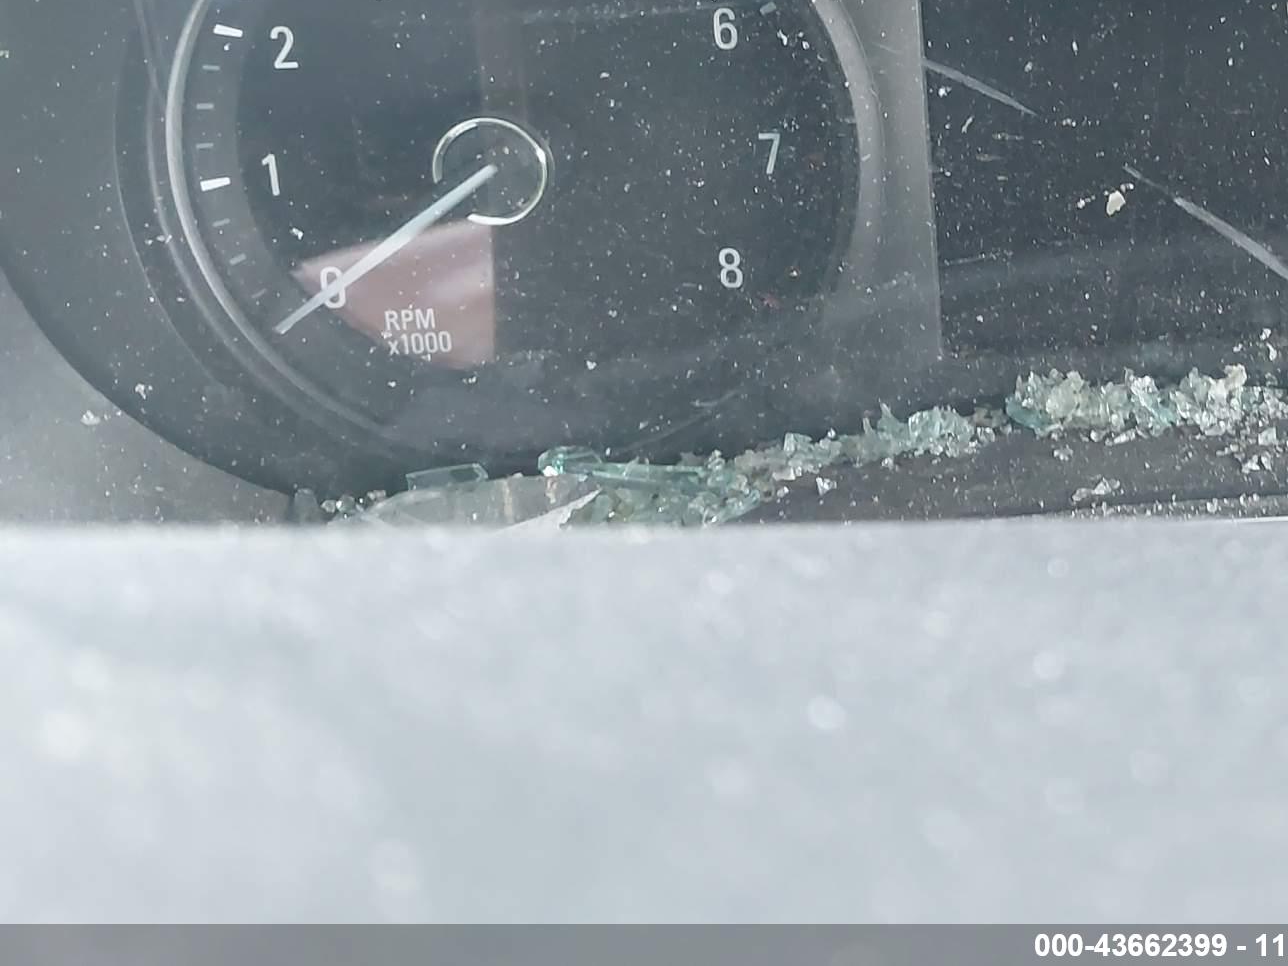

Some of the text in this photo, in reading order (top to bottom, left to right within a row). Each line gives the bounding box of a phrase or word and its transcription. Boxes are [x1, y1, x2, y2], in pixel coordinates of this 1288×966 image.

[271, 26, 299, 69] 2
[712, 7, 738, 50] 6
[262, 153, 281, 195] 1
[758, 133, 781, 175] 7
[719, 248, 743, 288] 8
[384, 309, 436, 330] RPM
[387, 331, 452, 355] x1000
